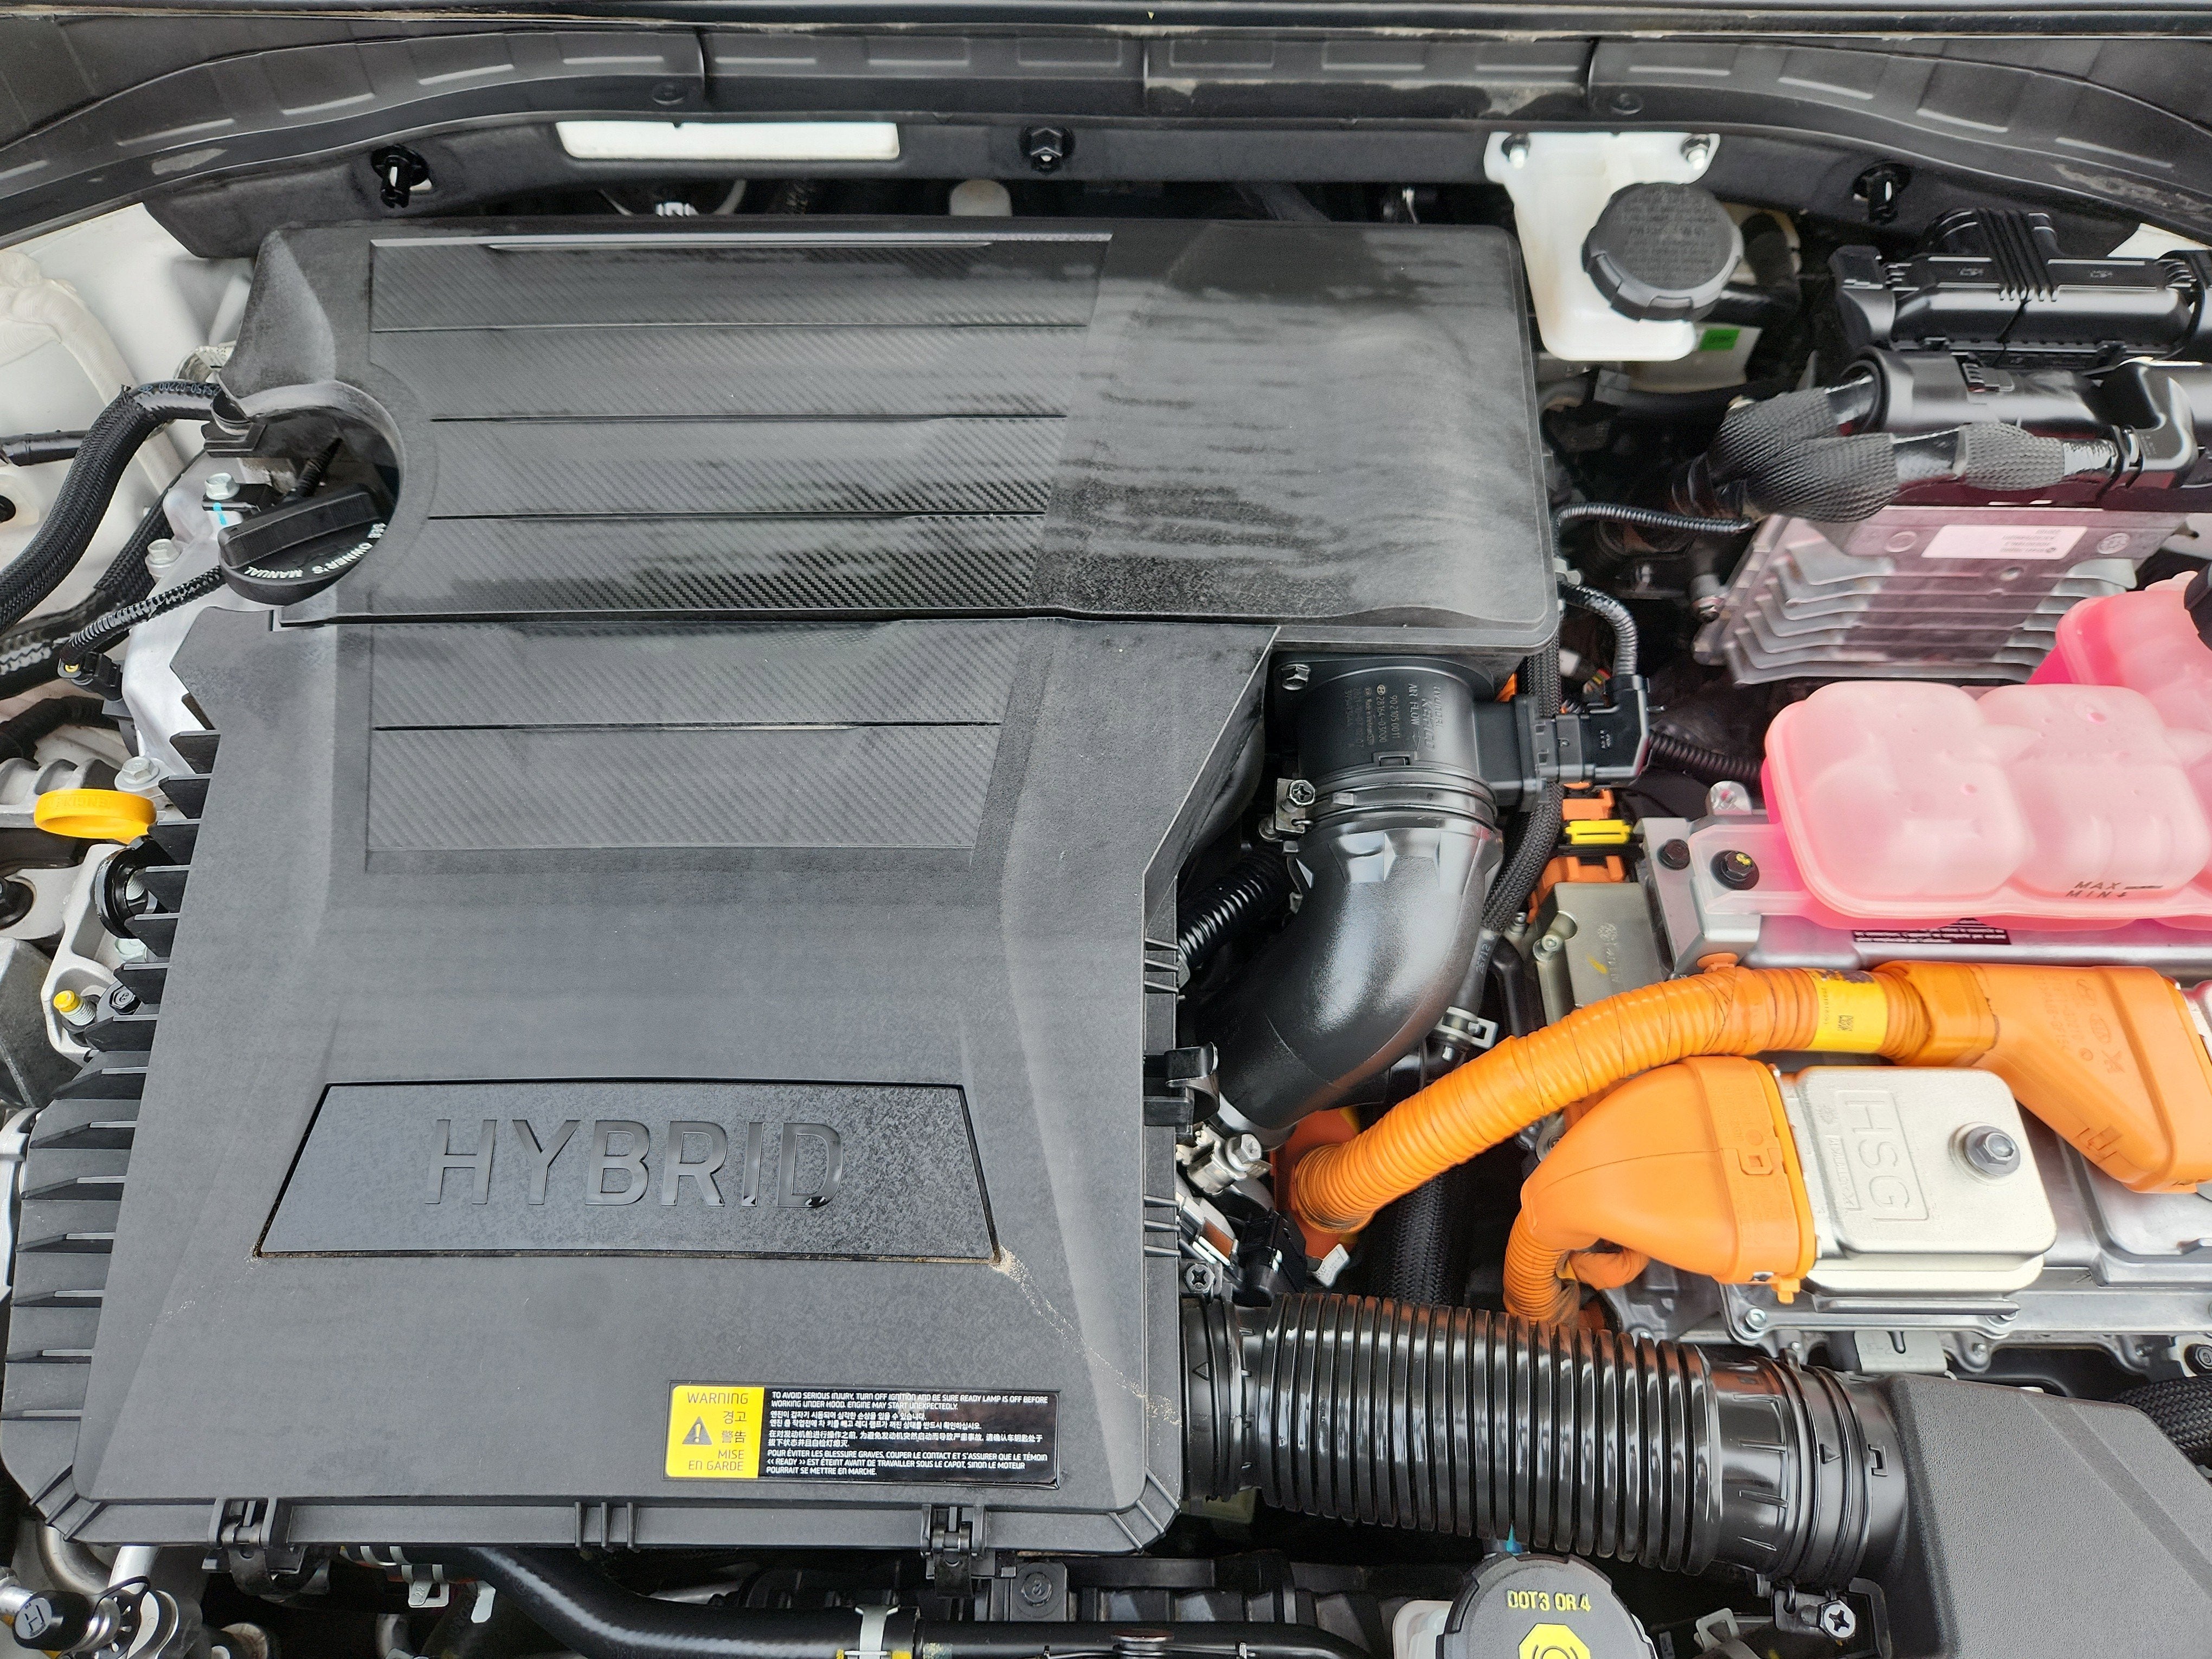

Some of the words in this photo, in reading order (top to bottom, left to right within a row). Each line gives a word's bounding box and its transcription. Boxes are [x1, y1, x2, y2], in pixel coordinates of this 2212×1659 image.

[311, 542, 372, 574] OWNER'S
[243, 566, 303, 579] MANUAL
[1408, 684, 1417, 697] AIR
[1410, 702, 1420, 725] FLOW
[2074, 880, 2121, 890] MAX
[2065, 890, 2112, 898] MIN
[1844, 1100, 1911, 1209] HSG
[424, 1118, 845, 1208] HYBRID
[687, 1392, 748, 1404] WARNING
[724, 1411, 747, 1424] 경고
[892, 1412, 898, 1420] 수
[722, 1430, 746, 1443] 警告
[718, 1450, 744, 1459] MISE
[787, 1448, 810, 1457] ÉVITER
[1023, 1452, 1048, 1461] TÉMOIN
[689, 1461, 702, 1470] EN
[707, 1461, 743, 1471] GARDE
[820, 1457, 844, 1466] ÉTEINT
[1507, 1590, 1551, 1611] DOT3
[1554, 1592, 1577, 1611] OR
[1580, 1593, 1592, 1612] 4
